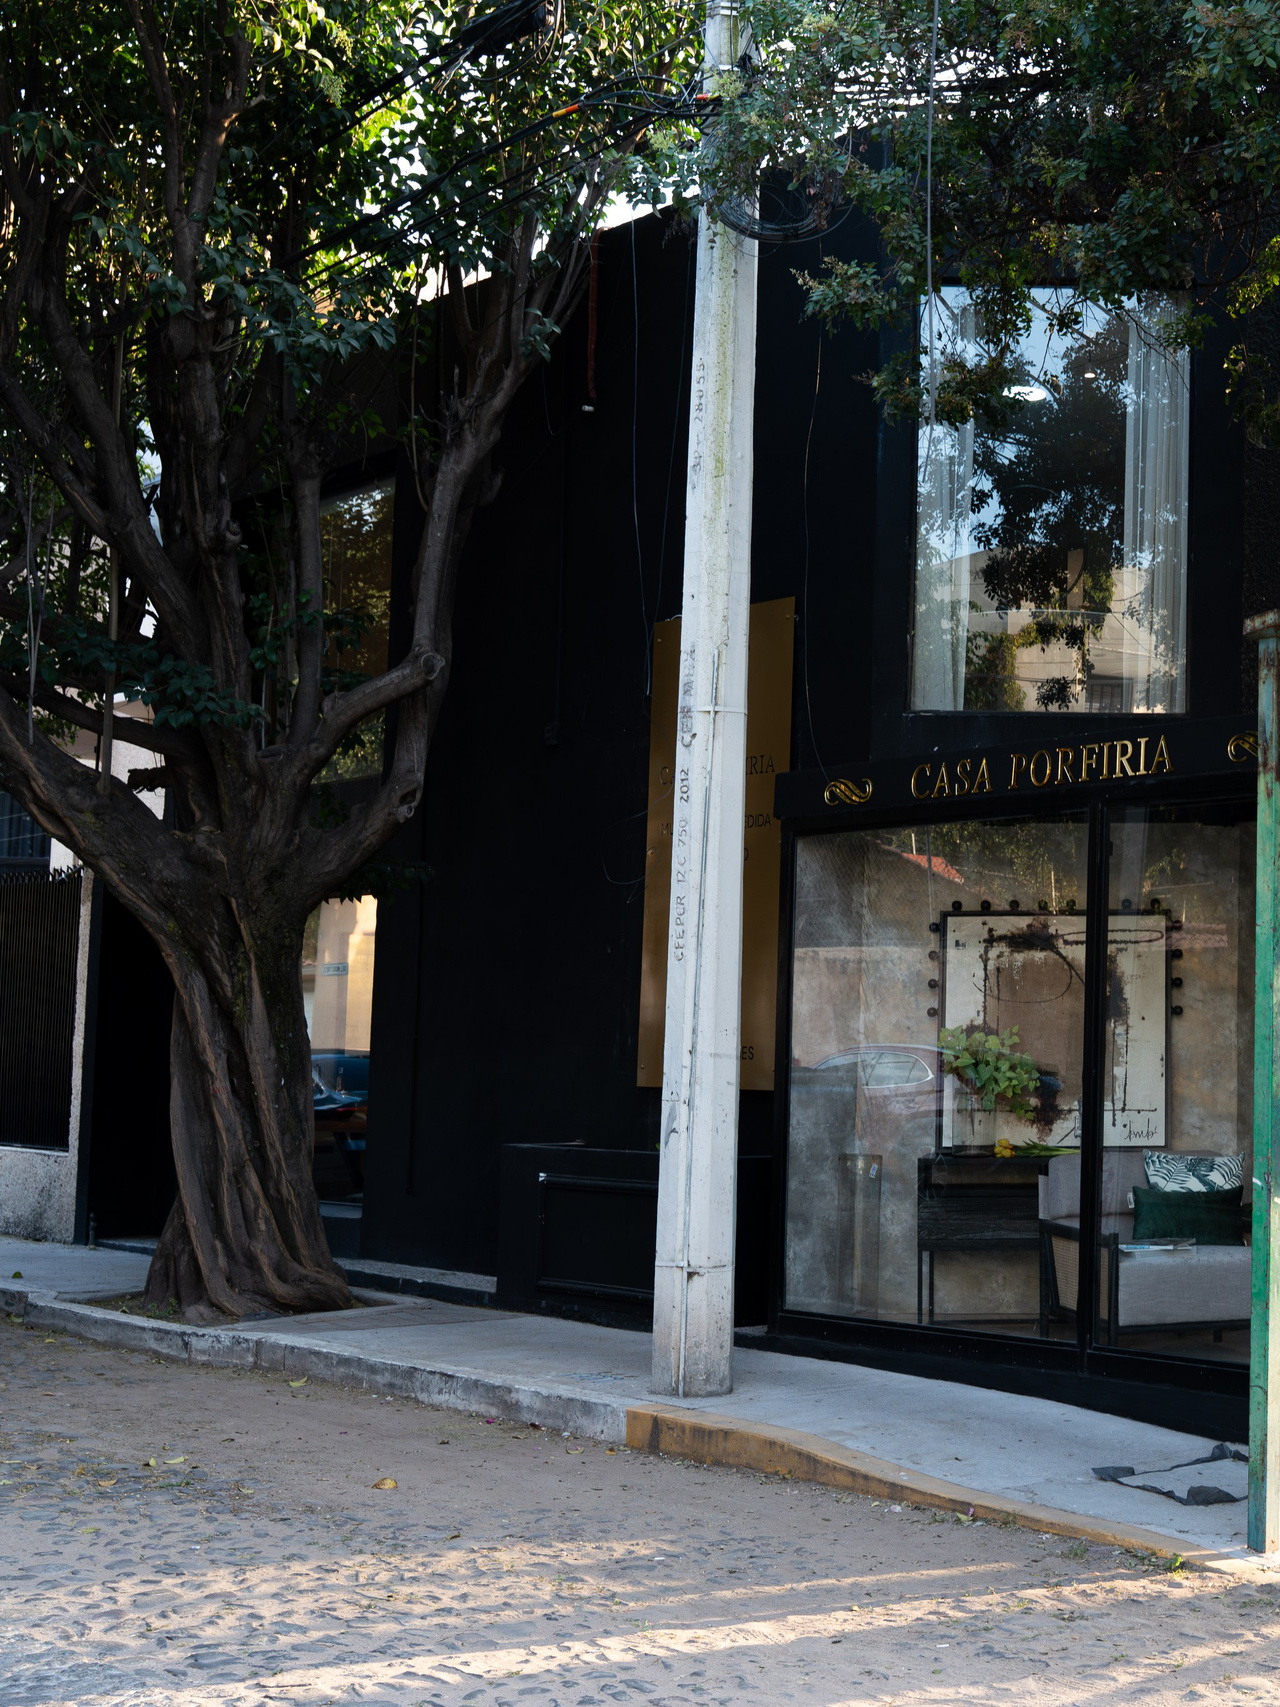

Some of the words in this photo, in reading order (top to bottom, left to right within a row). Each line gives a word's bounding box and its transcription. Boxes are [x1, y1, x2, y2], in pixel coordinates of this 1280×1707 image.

[679, 768, 689, 803] 2012
[910, 757, 994, 800] CASA
[1007, 734, 1175, 790] PORFIRIA
